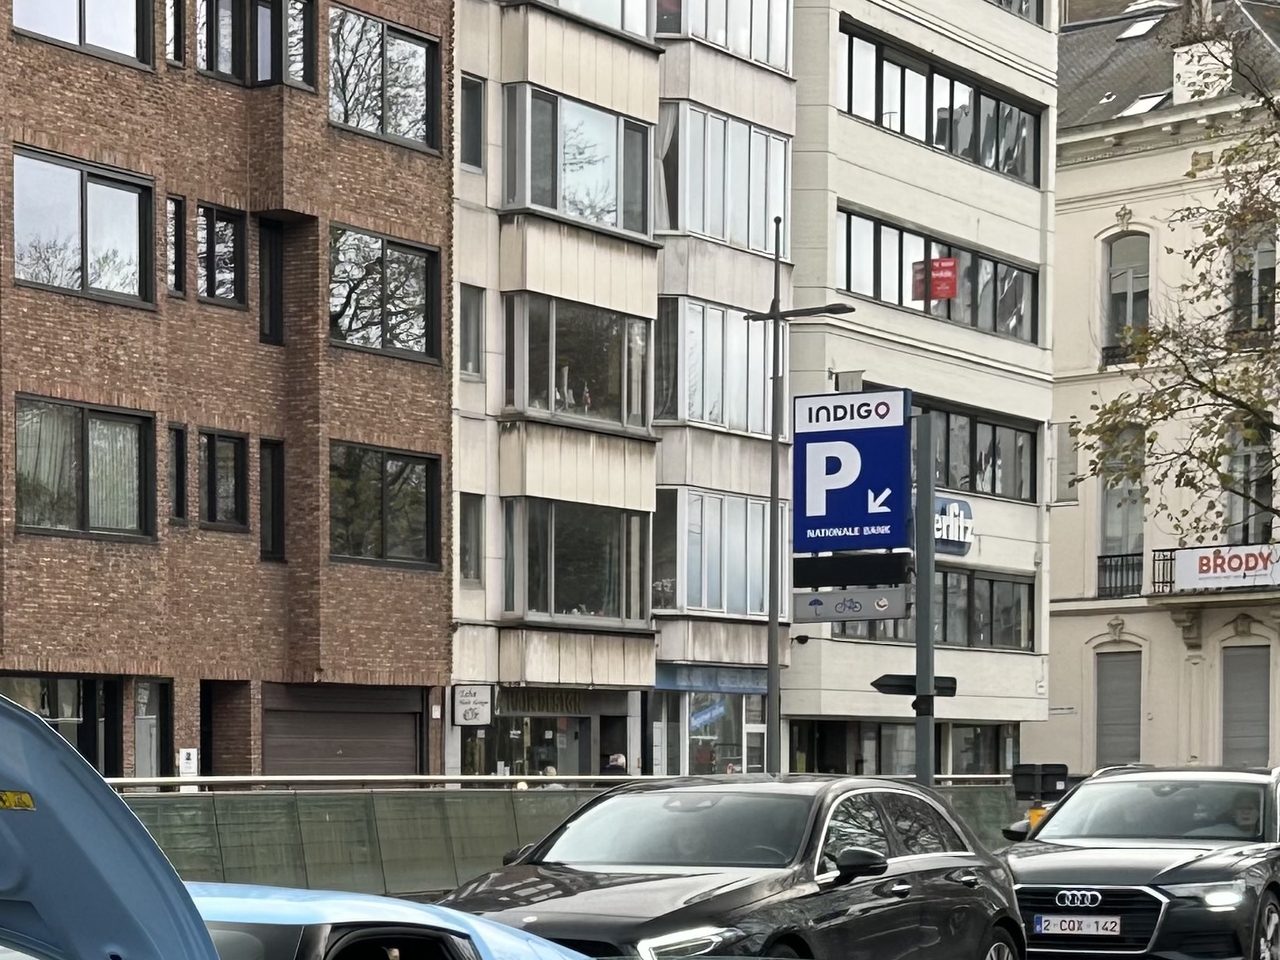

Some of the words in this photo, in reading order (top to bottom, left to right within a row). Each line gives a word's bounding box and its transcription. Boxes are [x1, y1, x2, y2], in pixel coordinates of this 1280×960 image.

[808, 401, 890, 423] INDIGO
[806, 441, 862, 517] P
[807, 527, 860, 538] NATIONALE
[1198, 552, 1272, 574] BRODY
